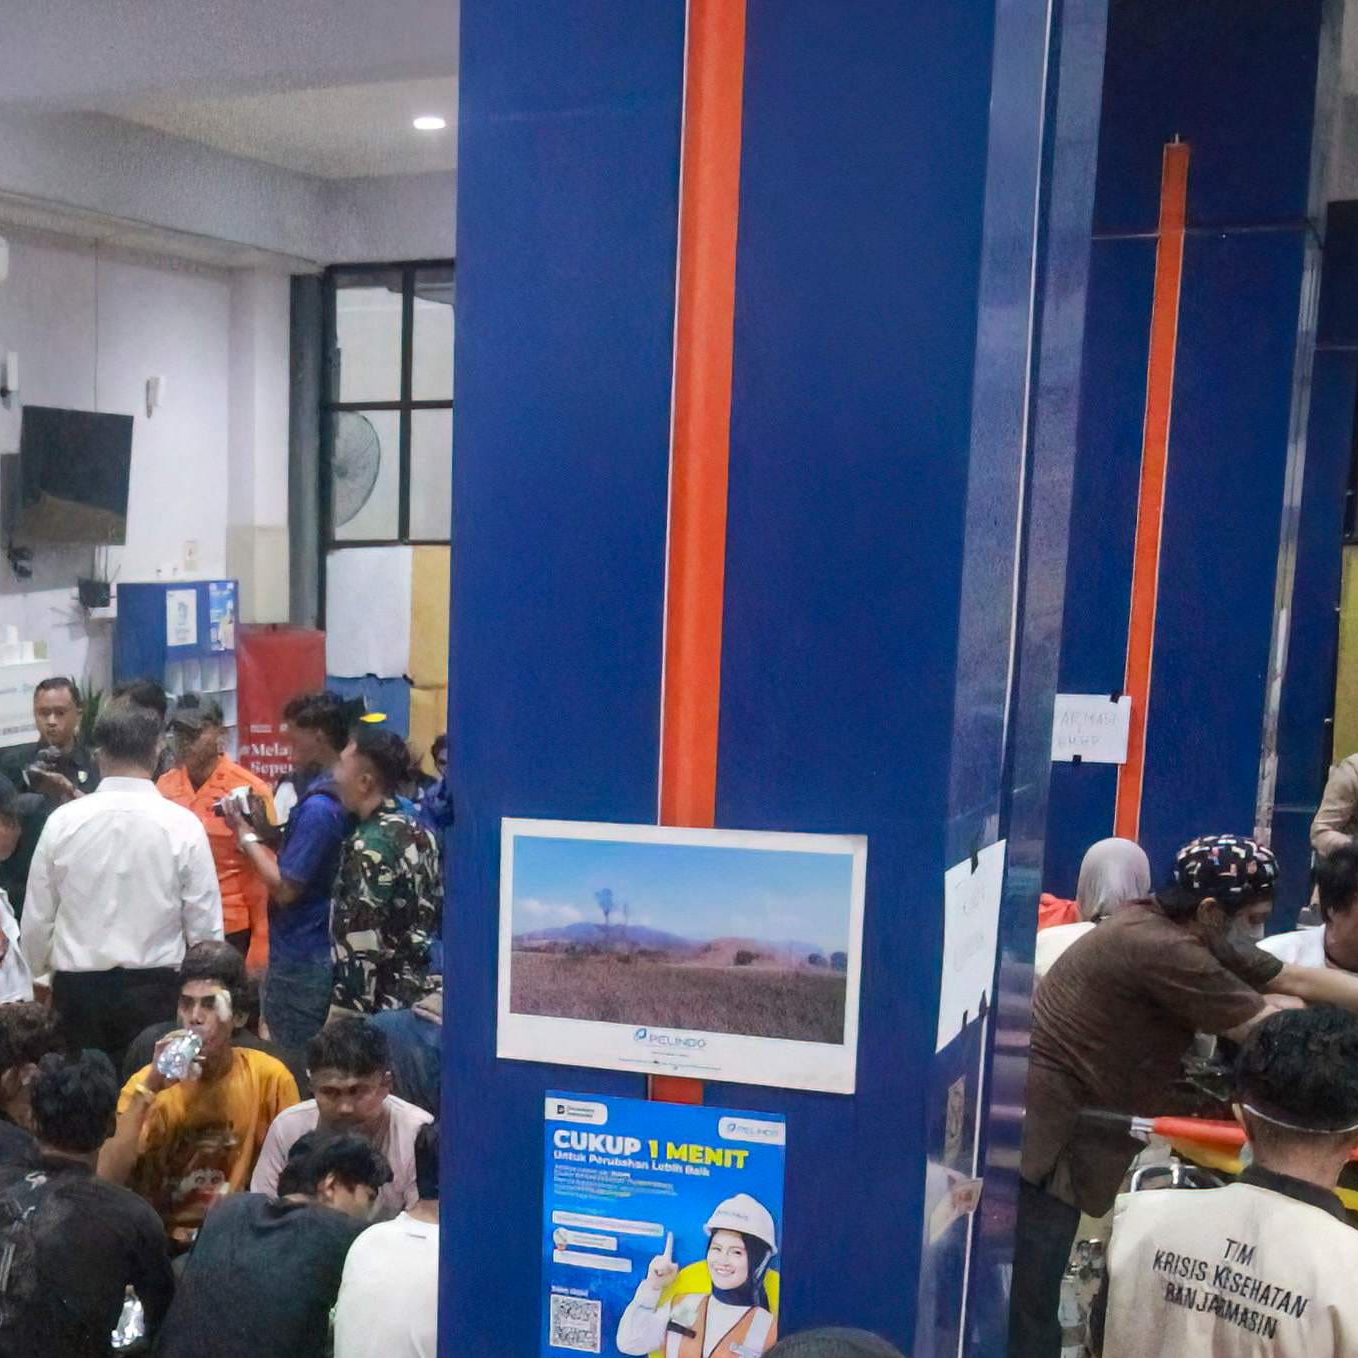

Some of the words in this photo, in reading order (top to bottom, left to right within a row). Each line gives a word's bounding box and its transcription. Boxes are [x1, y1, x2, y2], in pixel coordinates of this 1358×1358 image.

[553, 1129, 641, 1155] CUKUP
[648, 1139, 659, 1159] 1
[666, 1141, 750, 1169] MENIT
[553, 1150, 587, 1163] Untuk
[588, 1152, 649, 1170] Perubahan
[652, 1159, 683, 1175] Lebih
[685, 1164, 710, 1177] Baik
[1224, 1238, 1256, 1266] TIM
[1153, 1249, 1208, 1281] KRISIS
[1213, 1265, 1309, 1319] KESEHATAN
[1164, 1282, 1278, 1339] BANJARMASIN
